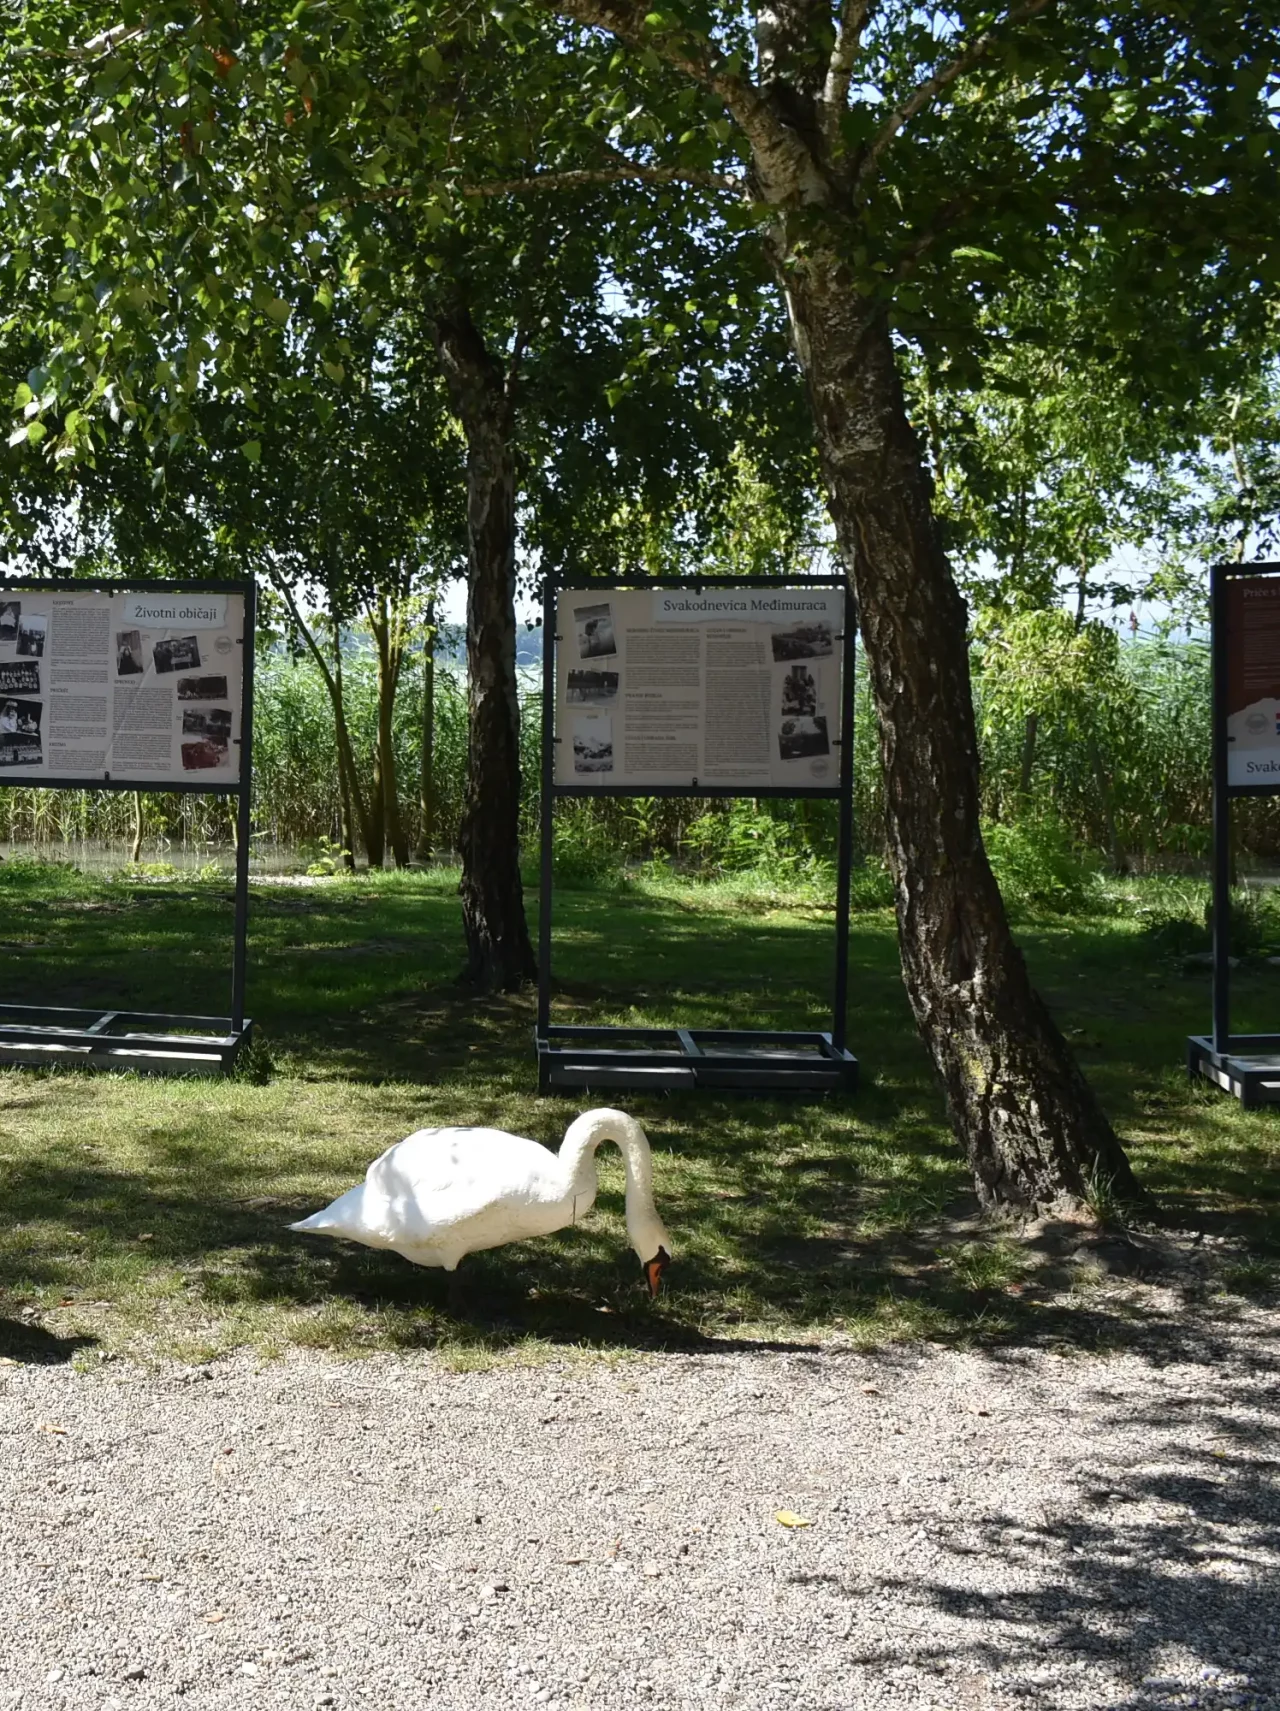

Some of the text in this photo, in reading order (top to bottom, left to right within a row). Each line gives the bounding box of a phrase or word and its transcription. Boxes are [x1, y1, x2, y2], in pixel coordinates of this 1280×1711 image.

[663, 600, 827, 611] Svakodnevica Međimuraca
[134, 605, 217, 621] Životni običaji
